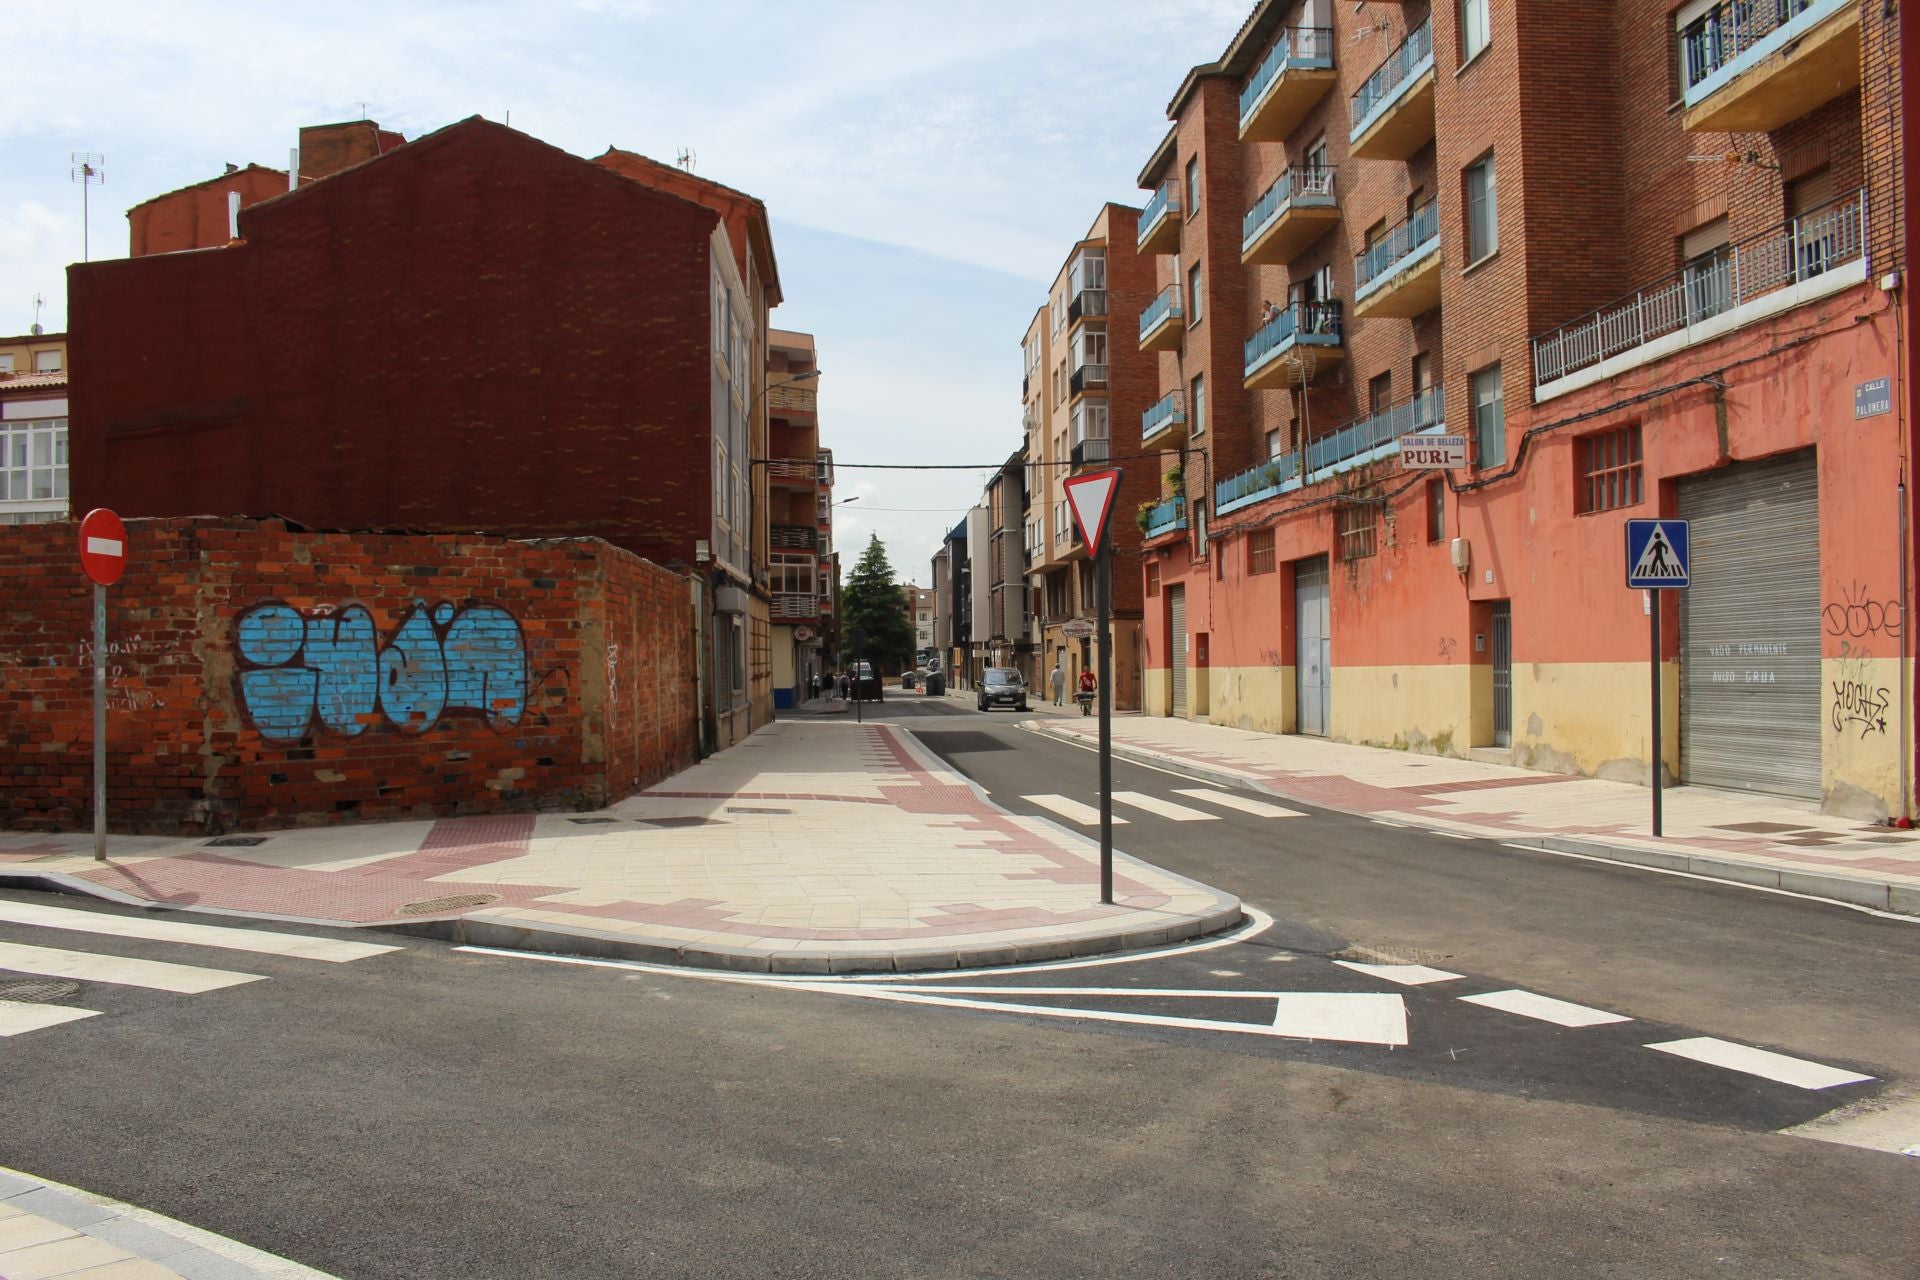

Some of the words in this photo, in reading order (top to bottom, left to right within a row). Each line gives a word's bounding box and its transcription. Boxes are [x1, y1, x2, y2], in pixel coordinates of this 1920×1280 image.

[1865, 380, 1885, 391] CALLE
[1857, 400, 1889, 416] PALOMERA
[1403, 437, 1424, 446] SALON
[1427, 437, 1435, 446] DE
[1438, 437, 1463, 446] BELLEZA
[1709, 644, 1731, 656] VADO
[1739, 643, 1787, 655] PERMANENTE
[1712, 671, 1735, 683] AVISO
[1745, 671, 1775, 683] GRUA
